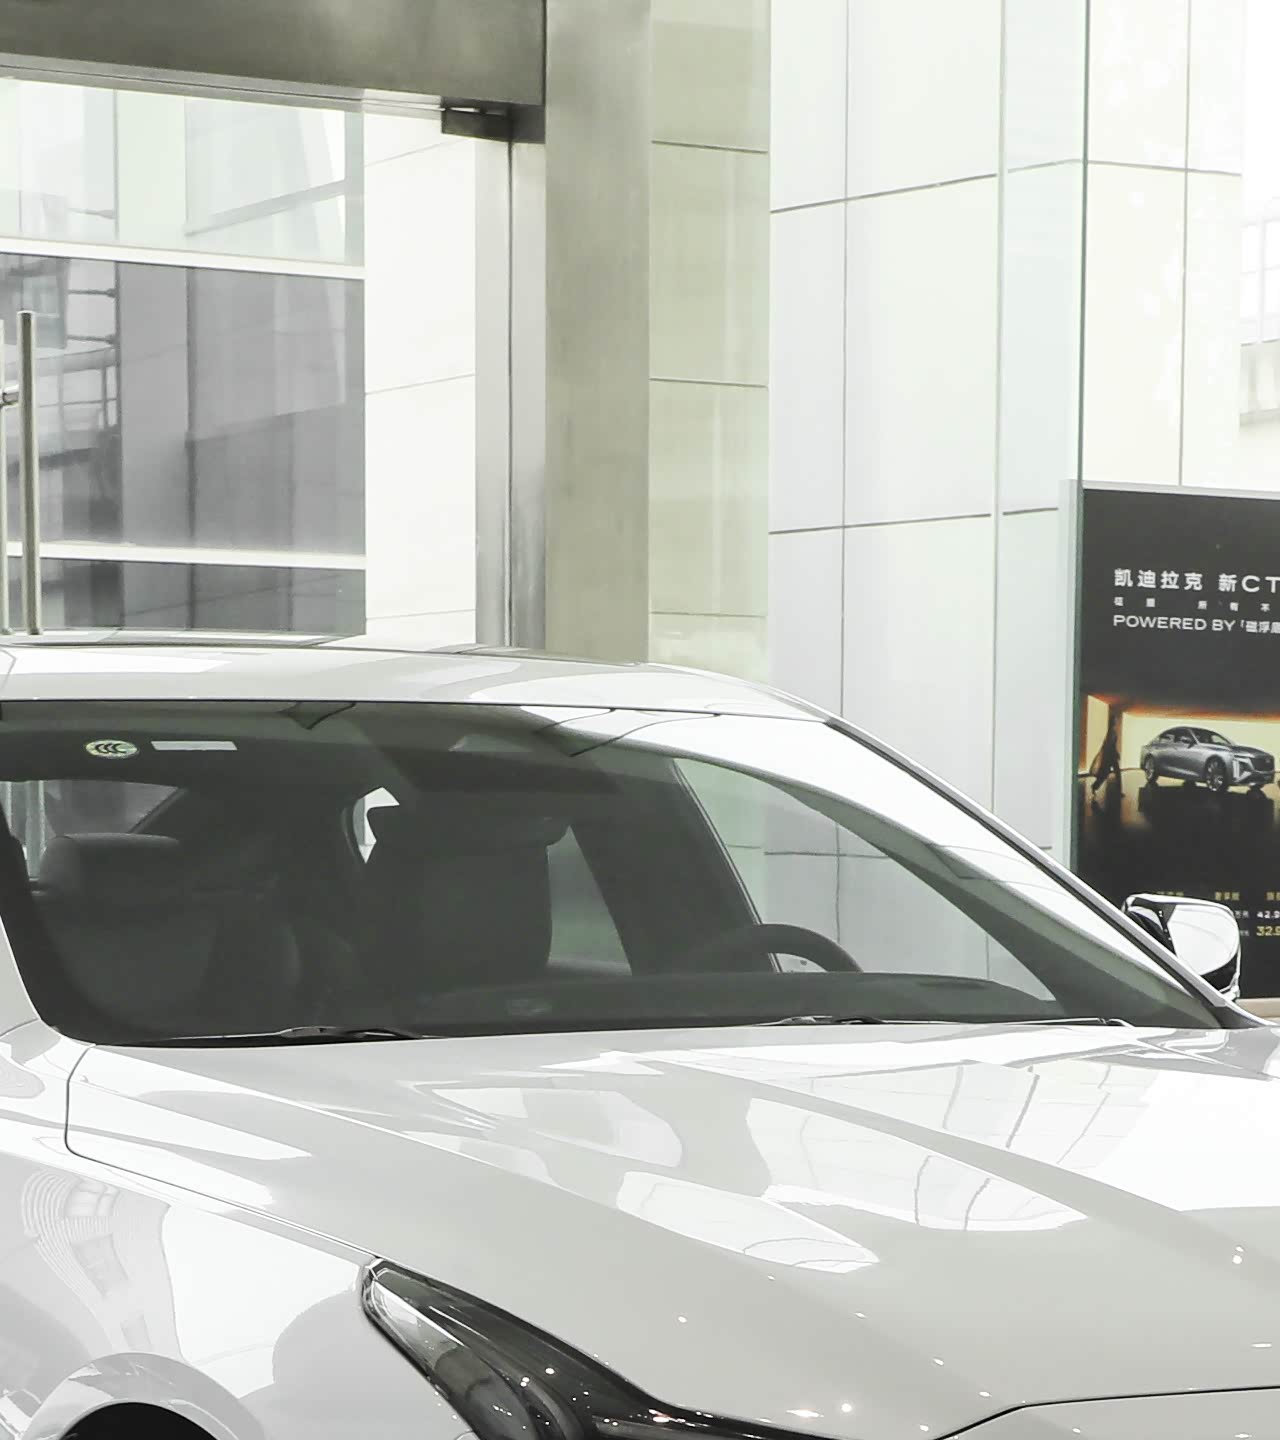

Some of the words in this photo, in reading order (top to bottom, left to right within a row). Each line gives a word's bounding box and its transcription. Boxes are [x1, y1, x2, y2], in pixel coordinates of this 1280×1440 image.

[1114, 568, 1203, 591] 凯迪拉克
[1113, 615, 1207, 631] POWERED
[1211, 619, 1236, 632] BY
